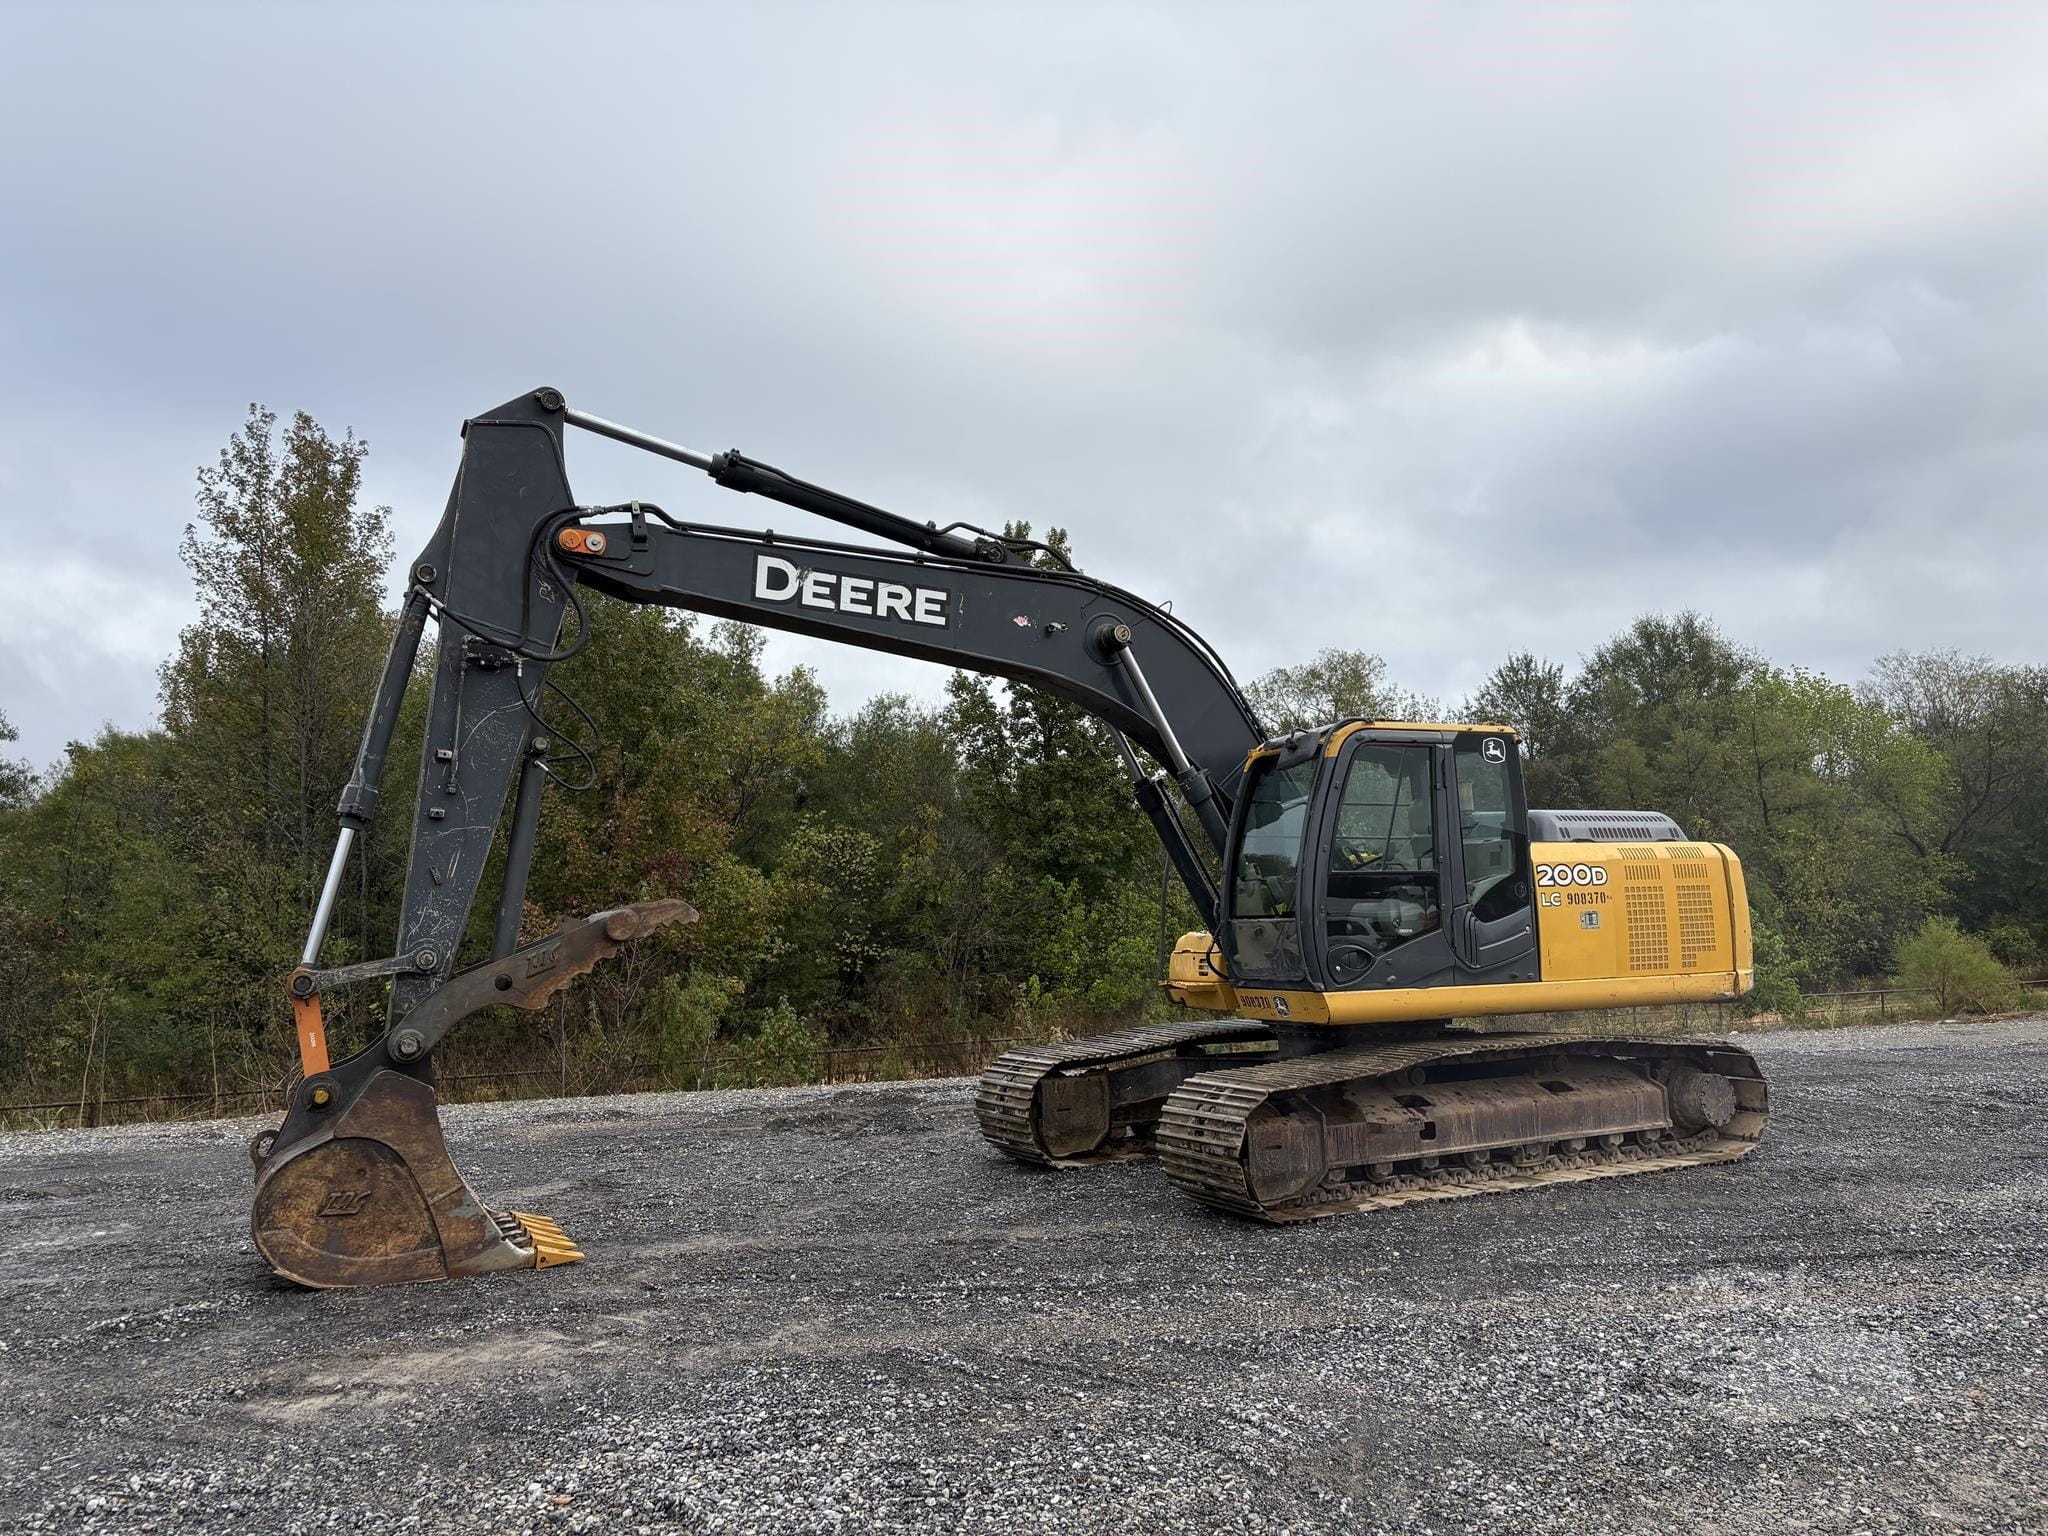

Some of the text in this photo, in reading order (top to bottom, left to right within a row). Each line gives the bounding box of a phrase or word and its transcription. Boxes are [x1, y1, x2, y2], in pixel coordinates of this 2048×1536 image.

[755, 555, 947, 626] DEERE
[1536, 863, 1608, 887] 200D
[1541, 891, 1606, 907] LC 908370
